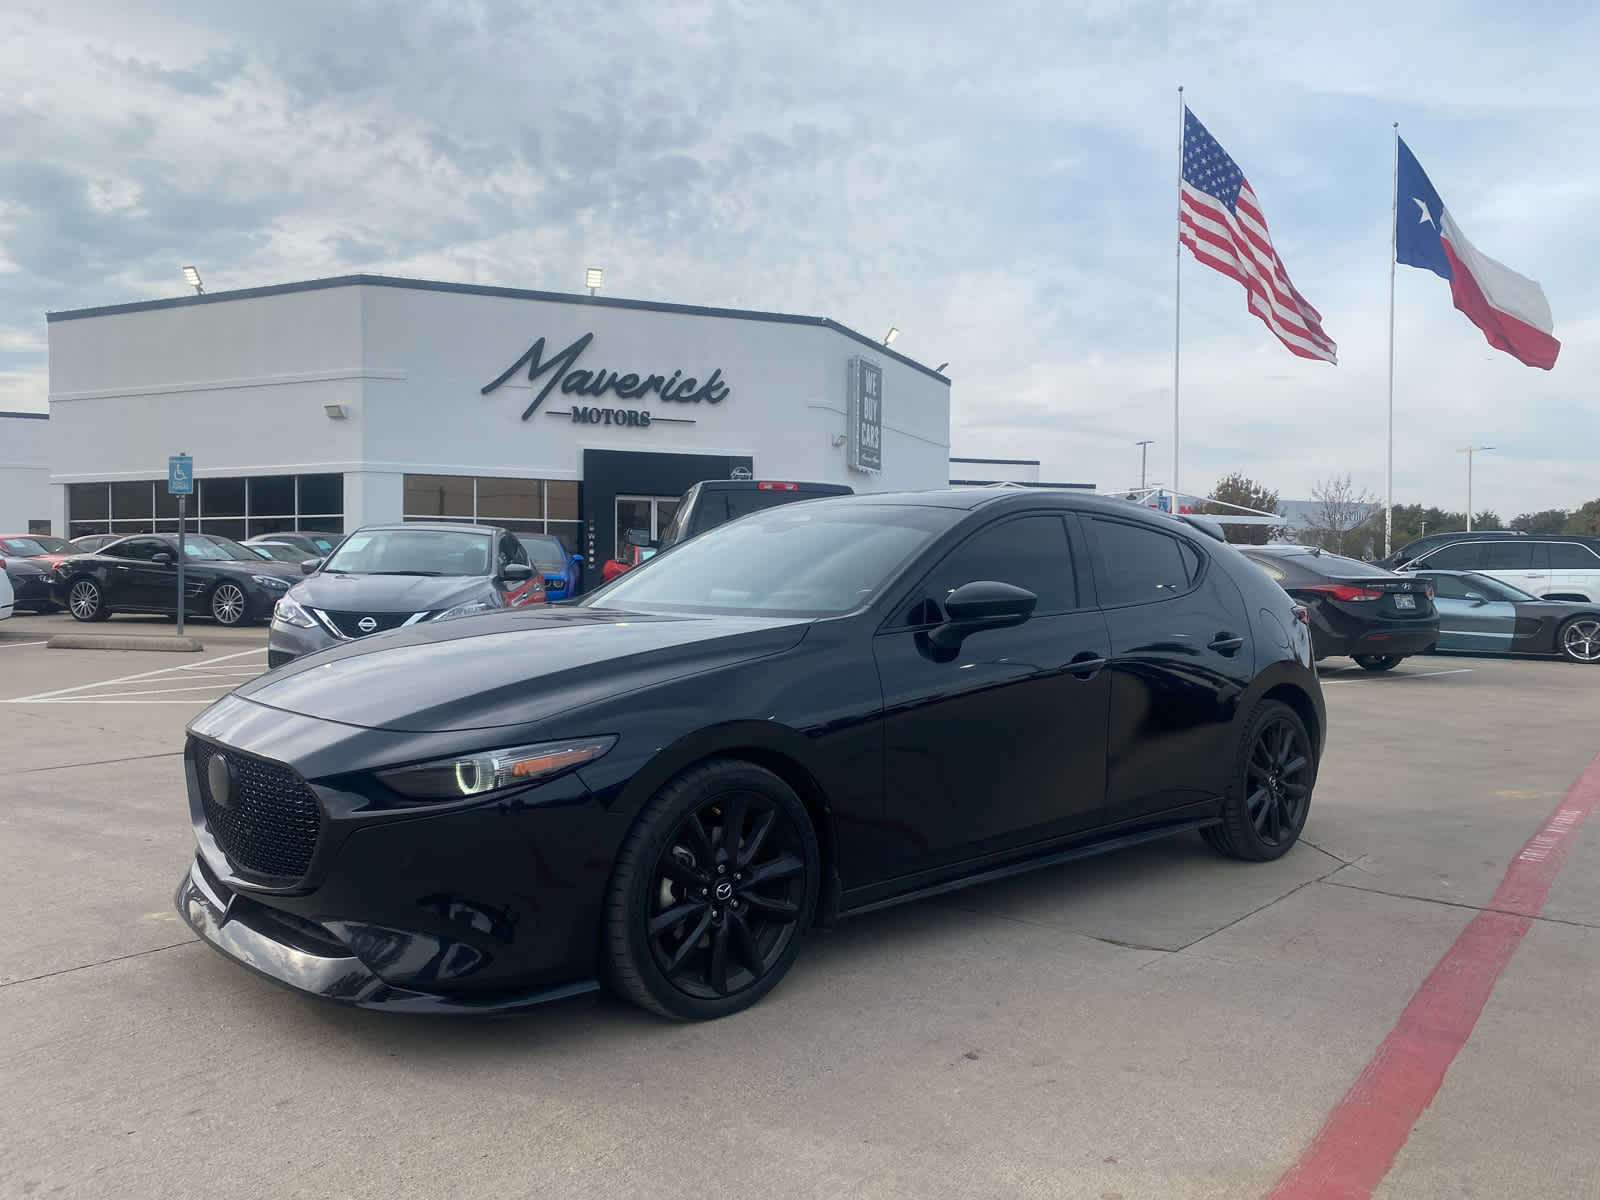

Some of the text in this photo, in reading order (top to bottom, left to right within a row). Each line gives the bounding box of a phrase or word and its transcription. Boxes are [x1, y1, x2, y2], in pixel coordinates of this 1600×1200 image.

[481, 332, 730, 421] Maverick
[865, 369, 877, 397] WE
[571, 406, 651, 427] MOTORS
[863, 396, 878, 424] BUY
[861, 422, 879, 449] CARS
